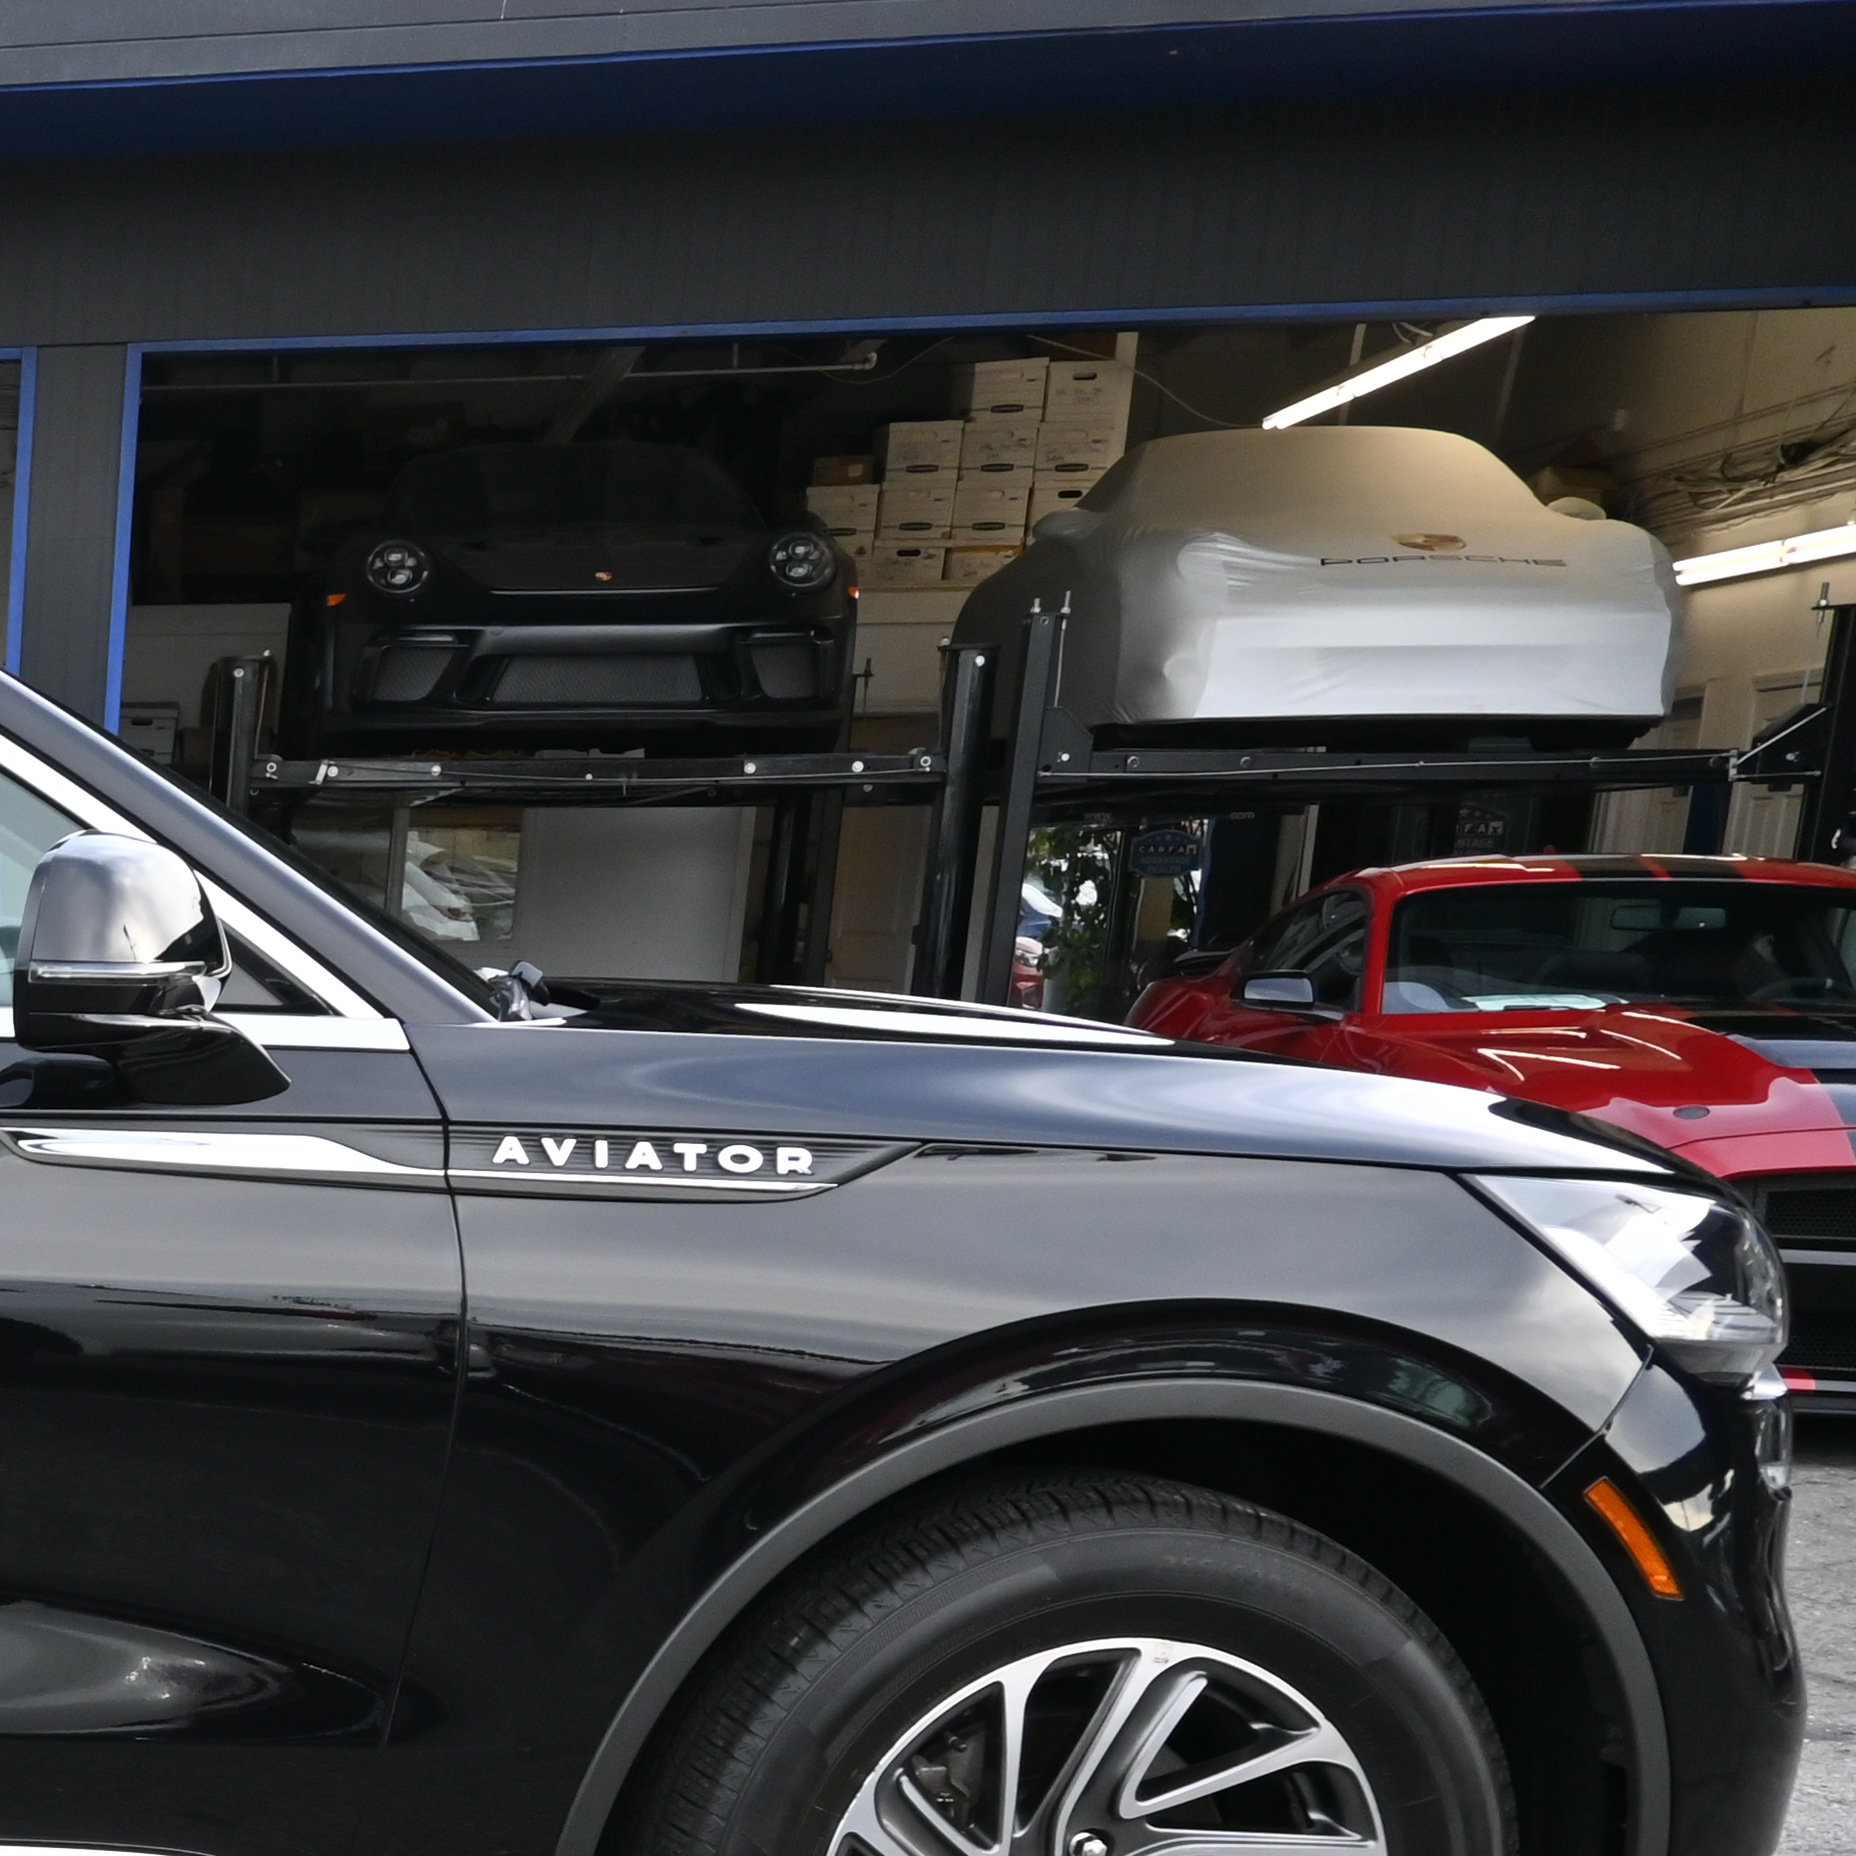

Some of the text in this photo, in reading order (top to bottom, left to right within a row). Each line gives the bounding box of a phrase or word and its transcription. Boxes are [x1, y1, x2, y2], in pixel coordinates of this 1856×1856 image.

[1320, 554, 1568, 567] PORSCHE
[1138, 844, 1198, 855] CARFAX
[492, 1135, 815, 1175] AVIATOR
